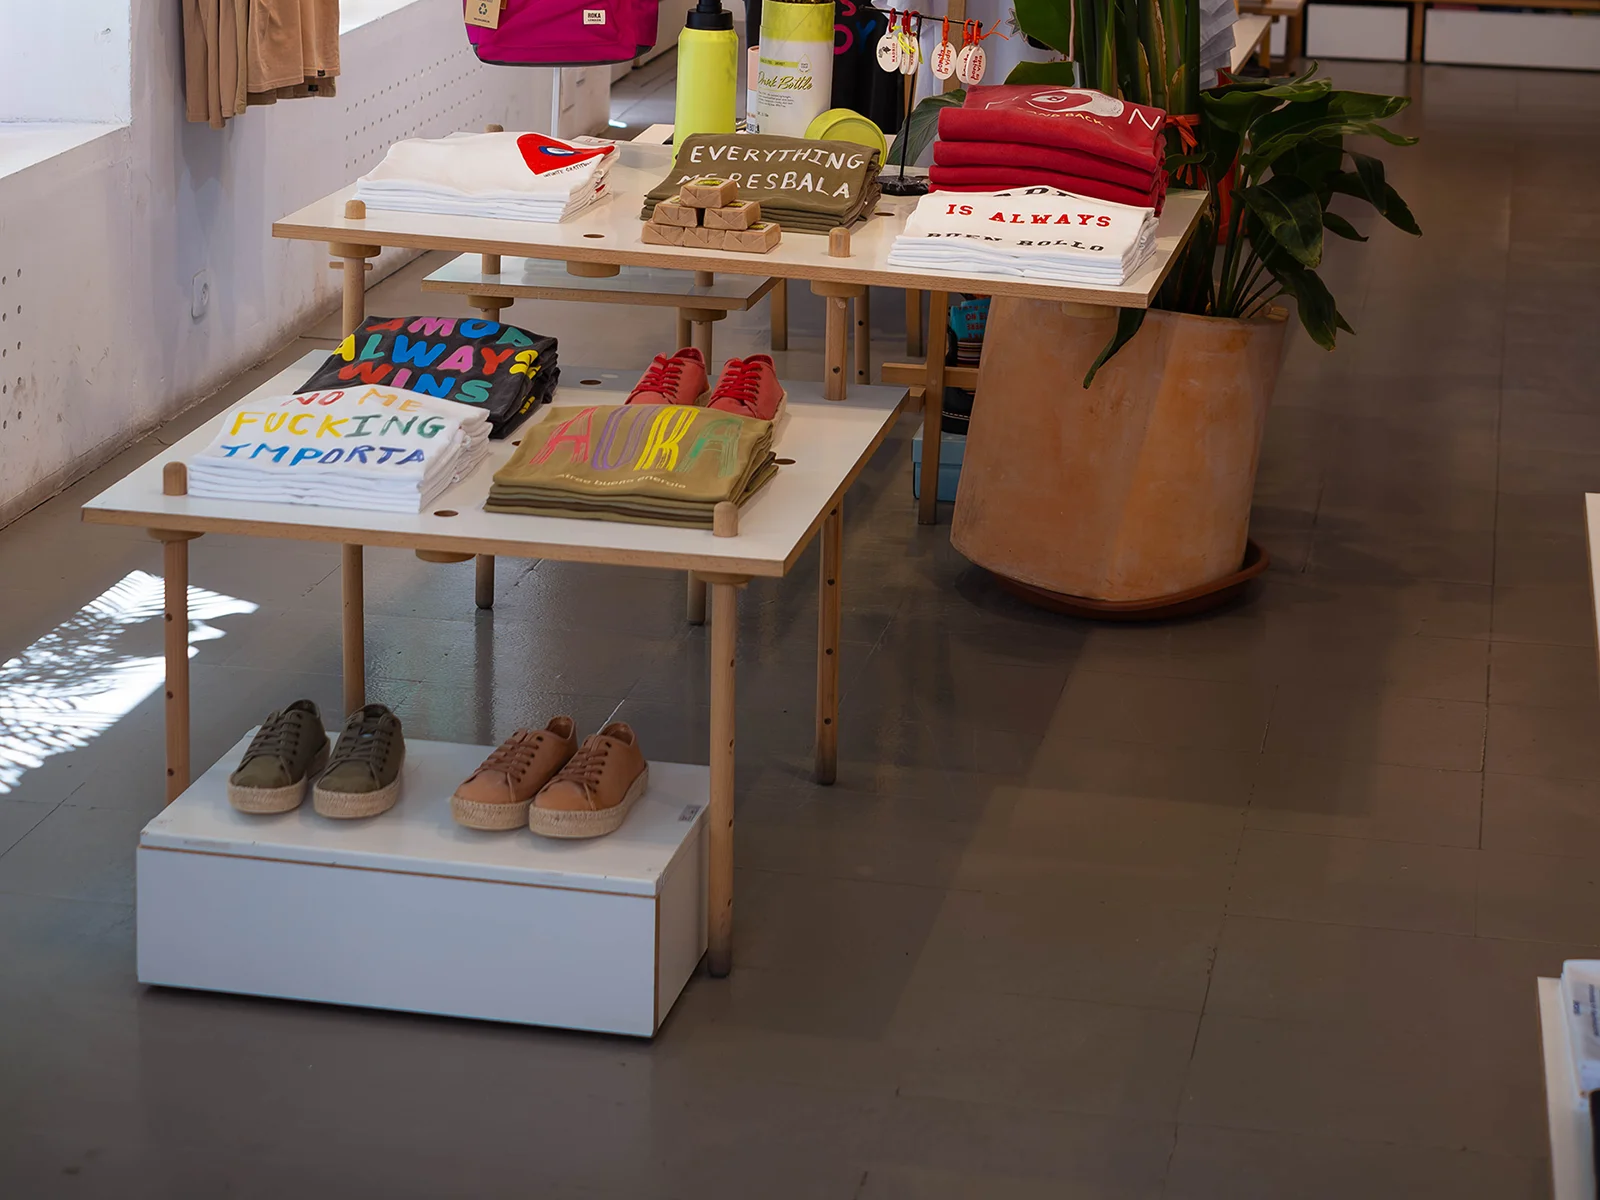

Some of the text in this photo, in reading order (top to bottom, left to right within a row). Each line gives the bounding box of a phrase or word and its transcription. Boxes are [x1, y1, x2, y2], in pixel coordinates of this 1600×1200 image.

[758, 71, 814, 90] Drink Bottle
[690, 145, 864, 170] EVERYTHING
[728, 171, 850, 199] RESBALA
[946, 204, 1113, 228] IS ALWAYS
[331, 333, 539, 376] ALWAYS
[338, 362, 493, 403] WINS
[281, 388, 423, 413] NO ME
[230, 411, 445, 439] FUCKING
[220, 443, 425, 467] IMPORTA
[594, 478, 634, 486] buena
